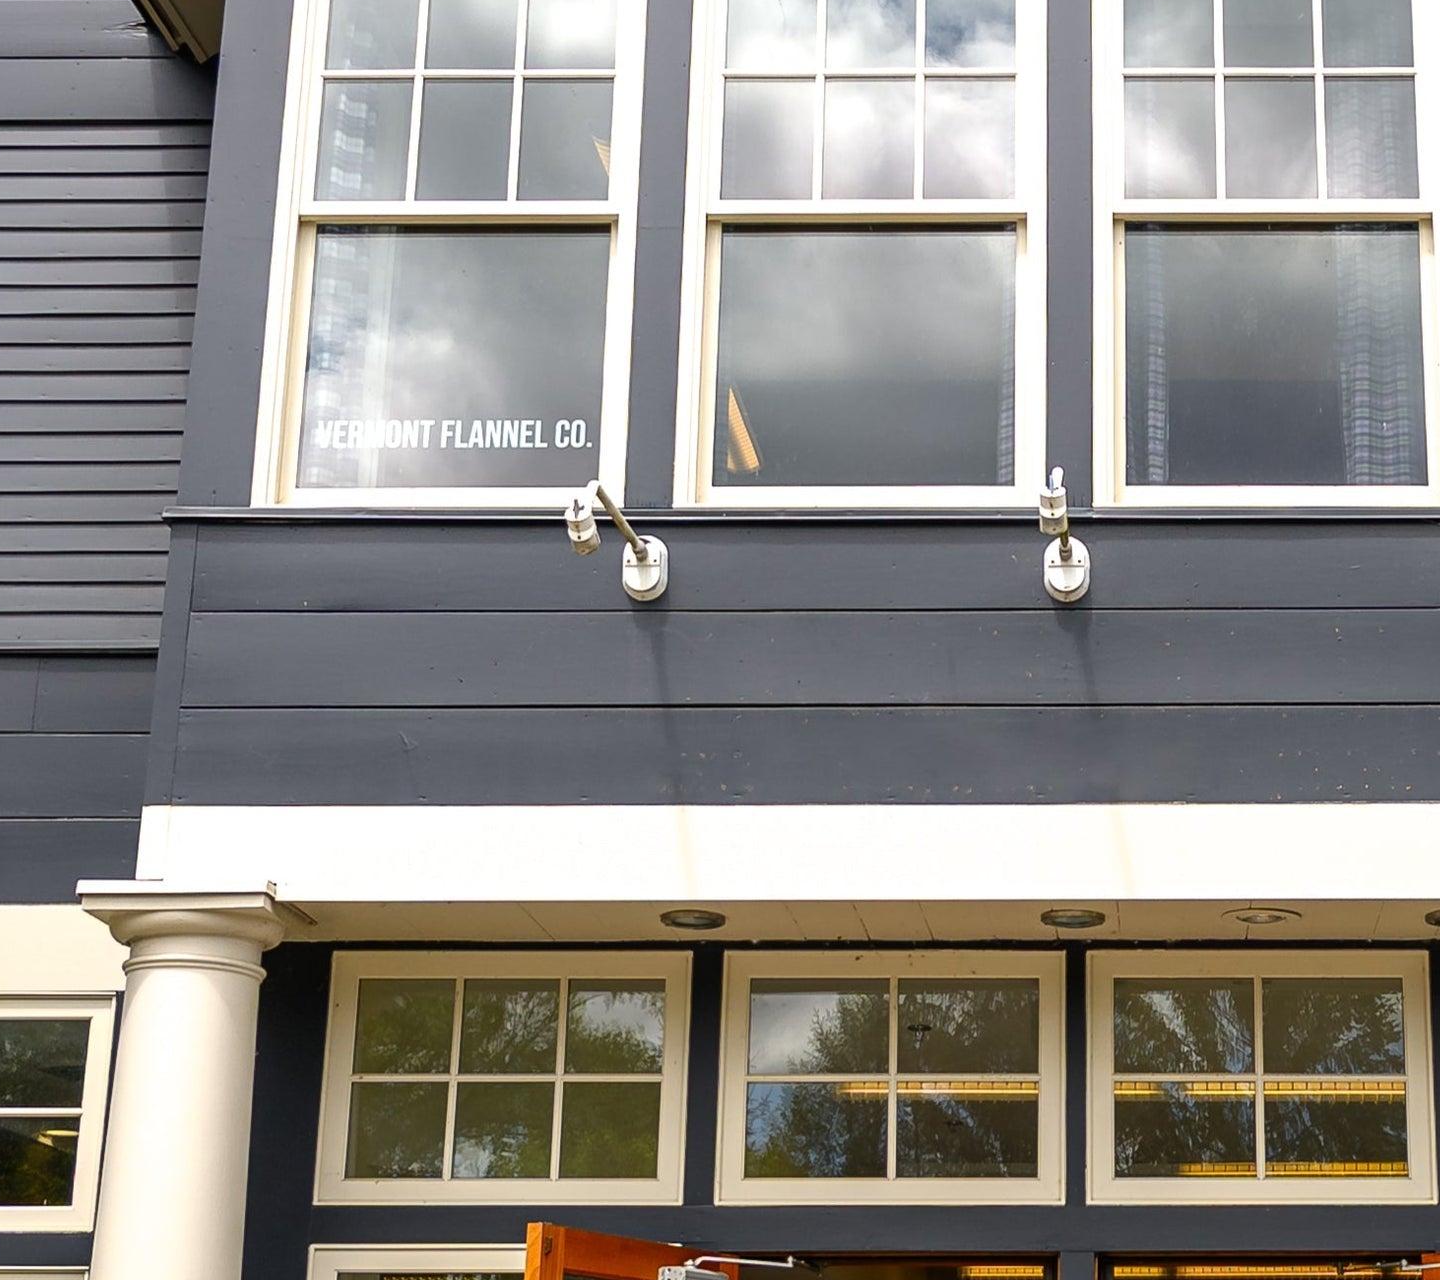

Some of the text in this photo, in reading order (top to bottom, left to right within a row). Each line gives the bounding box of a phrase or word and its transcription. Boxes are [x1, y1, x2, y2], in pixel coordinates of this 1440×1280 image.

[317, 419, 593, 449] VERMONT FLANNEL CO.
